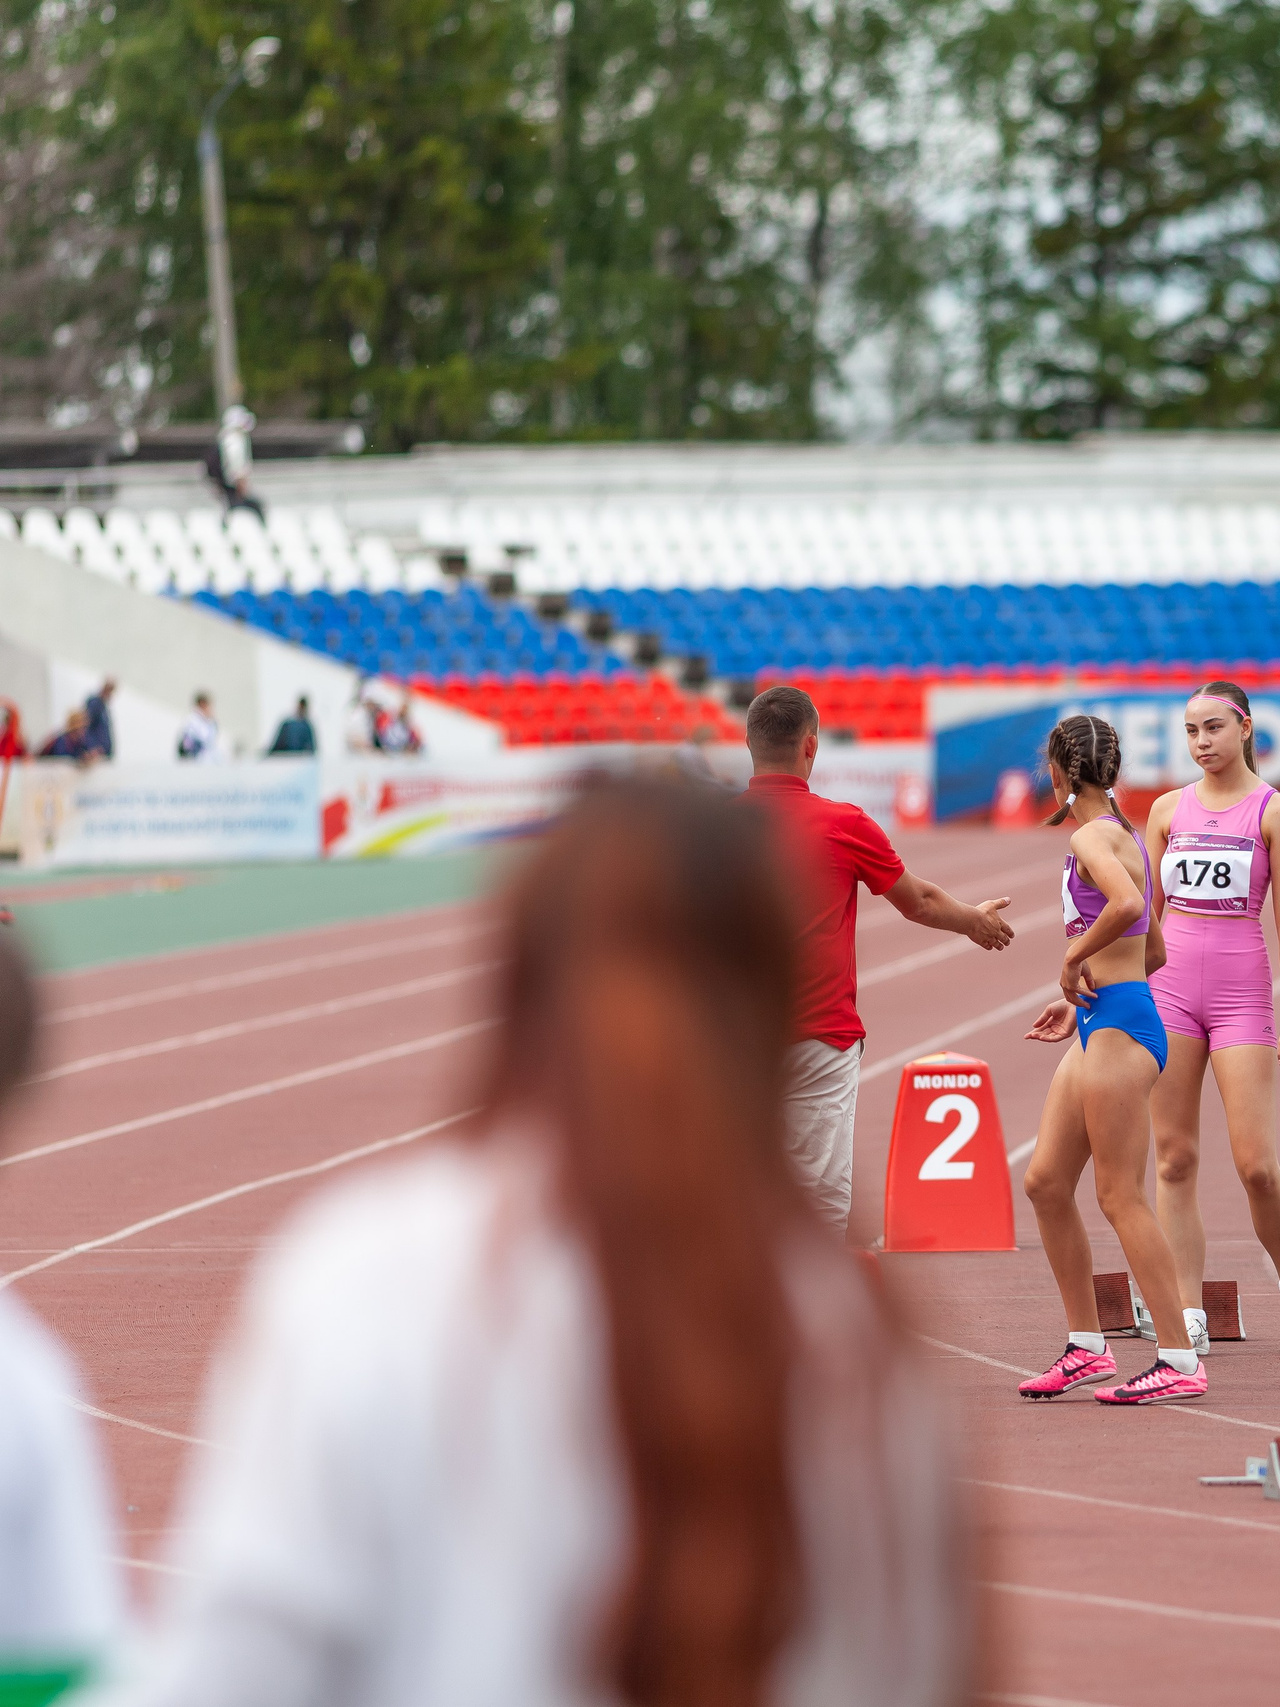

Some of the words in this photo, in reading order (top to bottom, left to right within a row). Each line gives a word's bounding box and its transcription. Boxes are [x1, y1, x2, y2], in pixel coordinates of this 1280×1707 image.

[1175, 859, 1231, 889] 178
[913, 1074, 982, 1089] MONDO
[918, 1093, 981, 1181] 2
